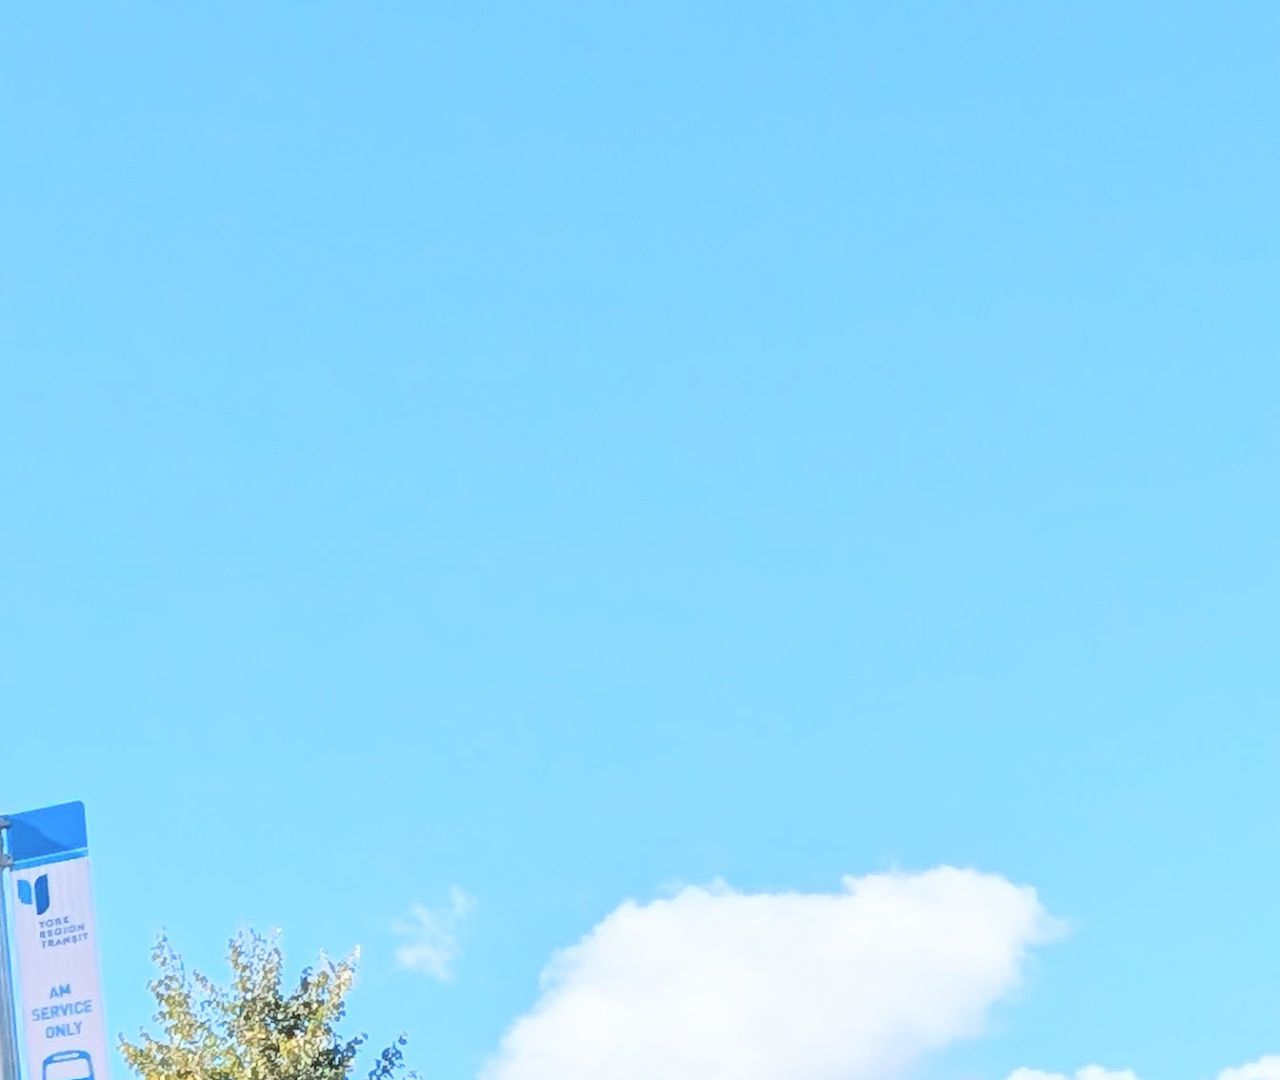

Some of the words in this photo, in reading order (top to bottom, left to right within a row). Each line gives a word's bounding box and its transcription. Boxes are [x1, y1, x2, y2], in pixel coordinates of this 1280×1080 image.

[39, 916, 69, 929] YORK
[40, 923, 85, 938] REGION
[41, 932, 88, 949] TRANSIT
[49, 984, 71, 999] AM
[32, 1000, 93, 1022] SERVICE
[45, 1022, 82, 1039] ONLY
